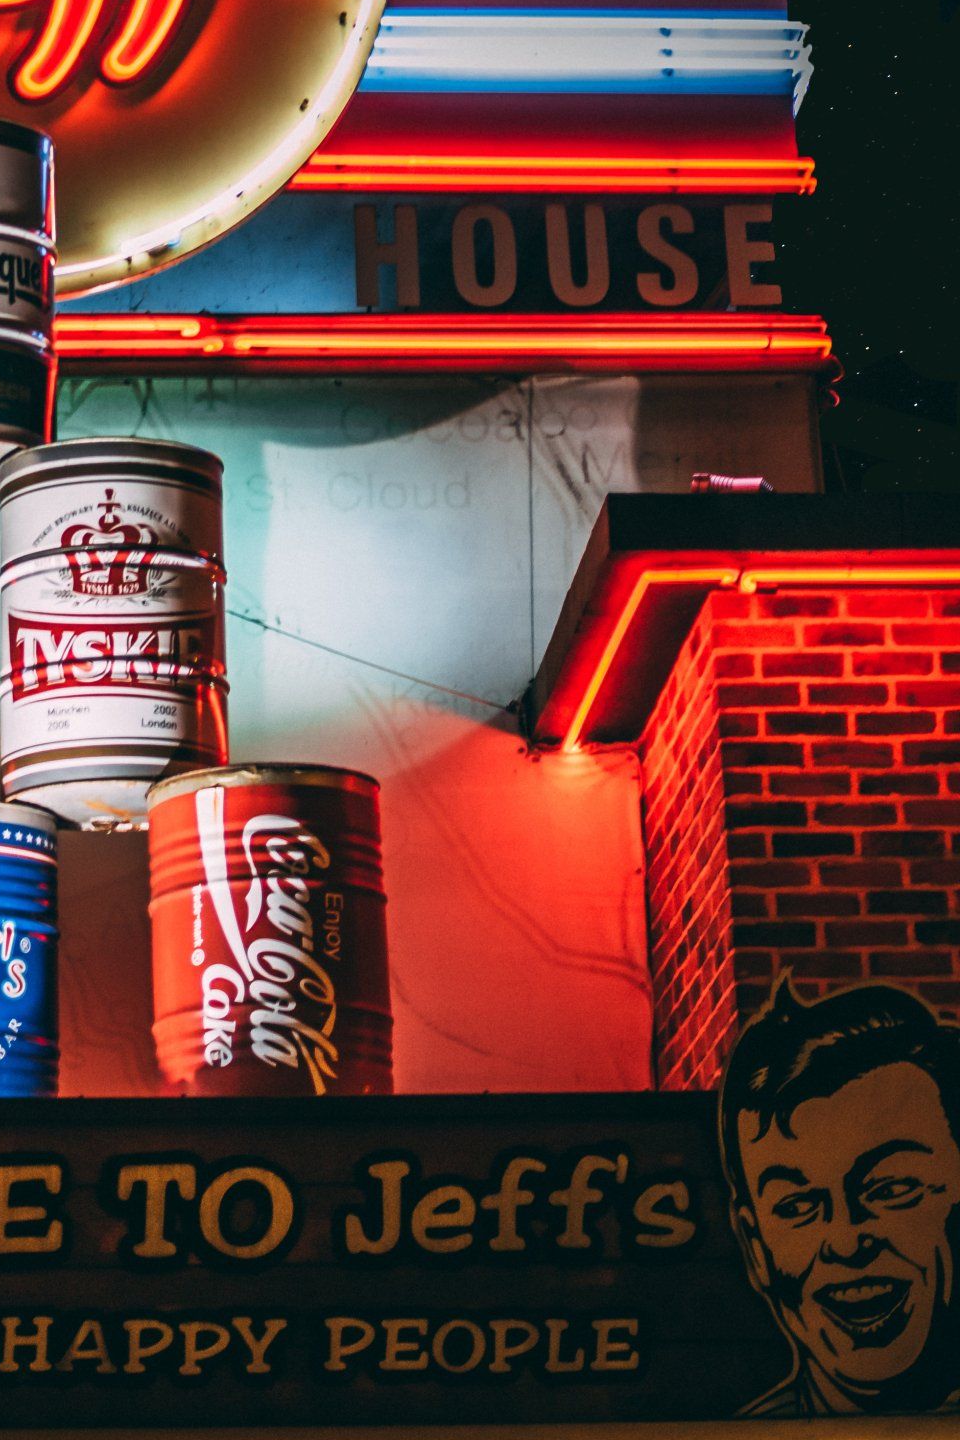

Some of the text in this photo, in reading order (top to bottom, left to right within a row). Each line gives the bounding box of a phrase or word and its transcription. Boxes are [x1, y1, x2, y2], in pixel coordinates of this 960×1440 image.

[353, 203, 782, 308] HOUSE
[329, 471, 471, 511] Cloud
[81, 582, 114, 595] TYSKIE
[141, 717, 178, 731] London
[153, 704, 178, 716] 2002
[201, 962, 246, 1068] Coke
[116, 1162, 295, 1259] TO
[345, 1153, 697, 1255] Jeff's
[323, 1315, 640, 1373] PEOPLE
